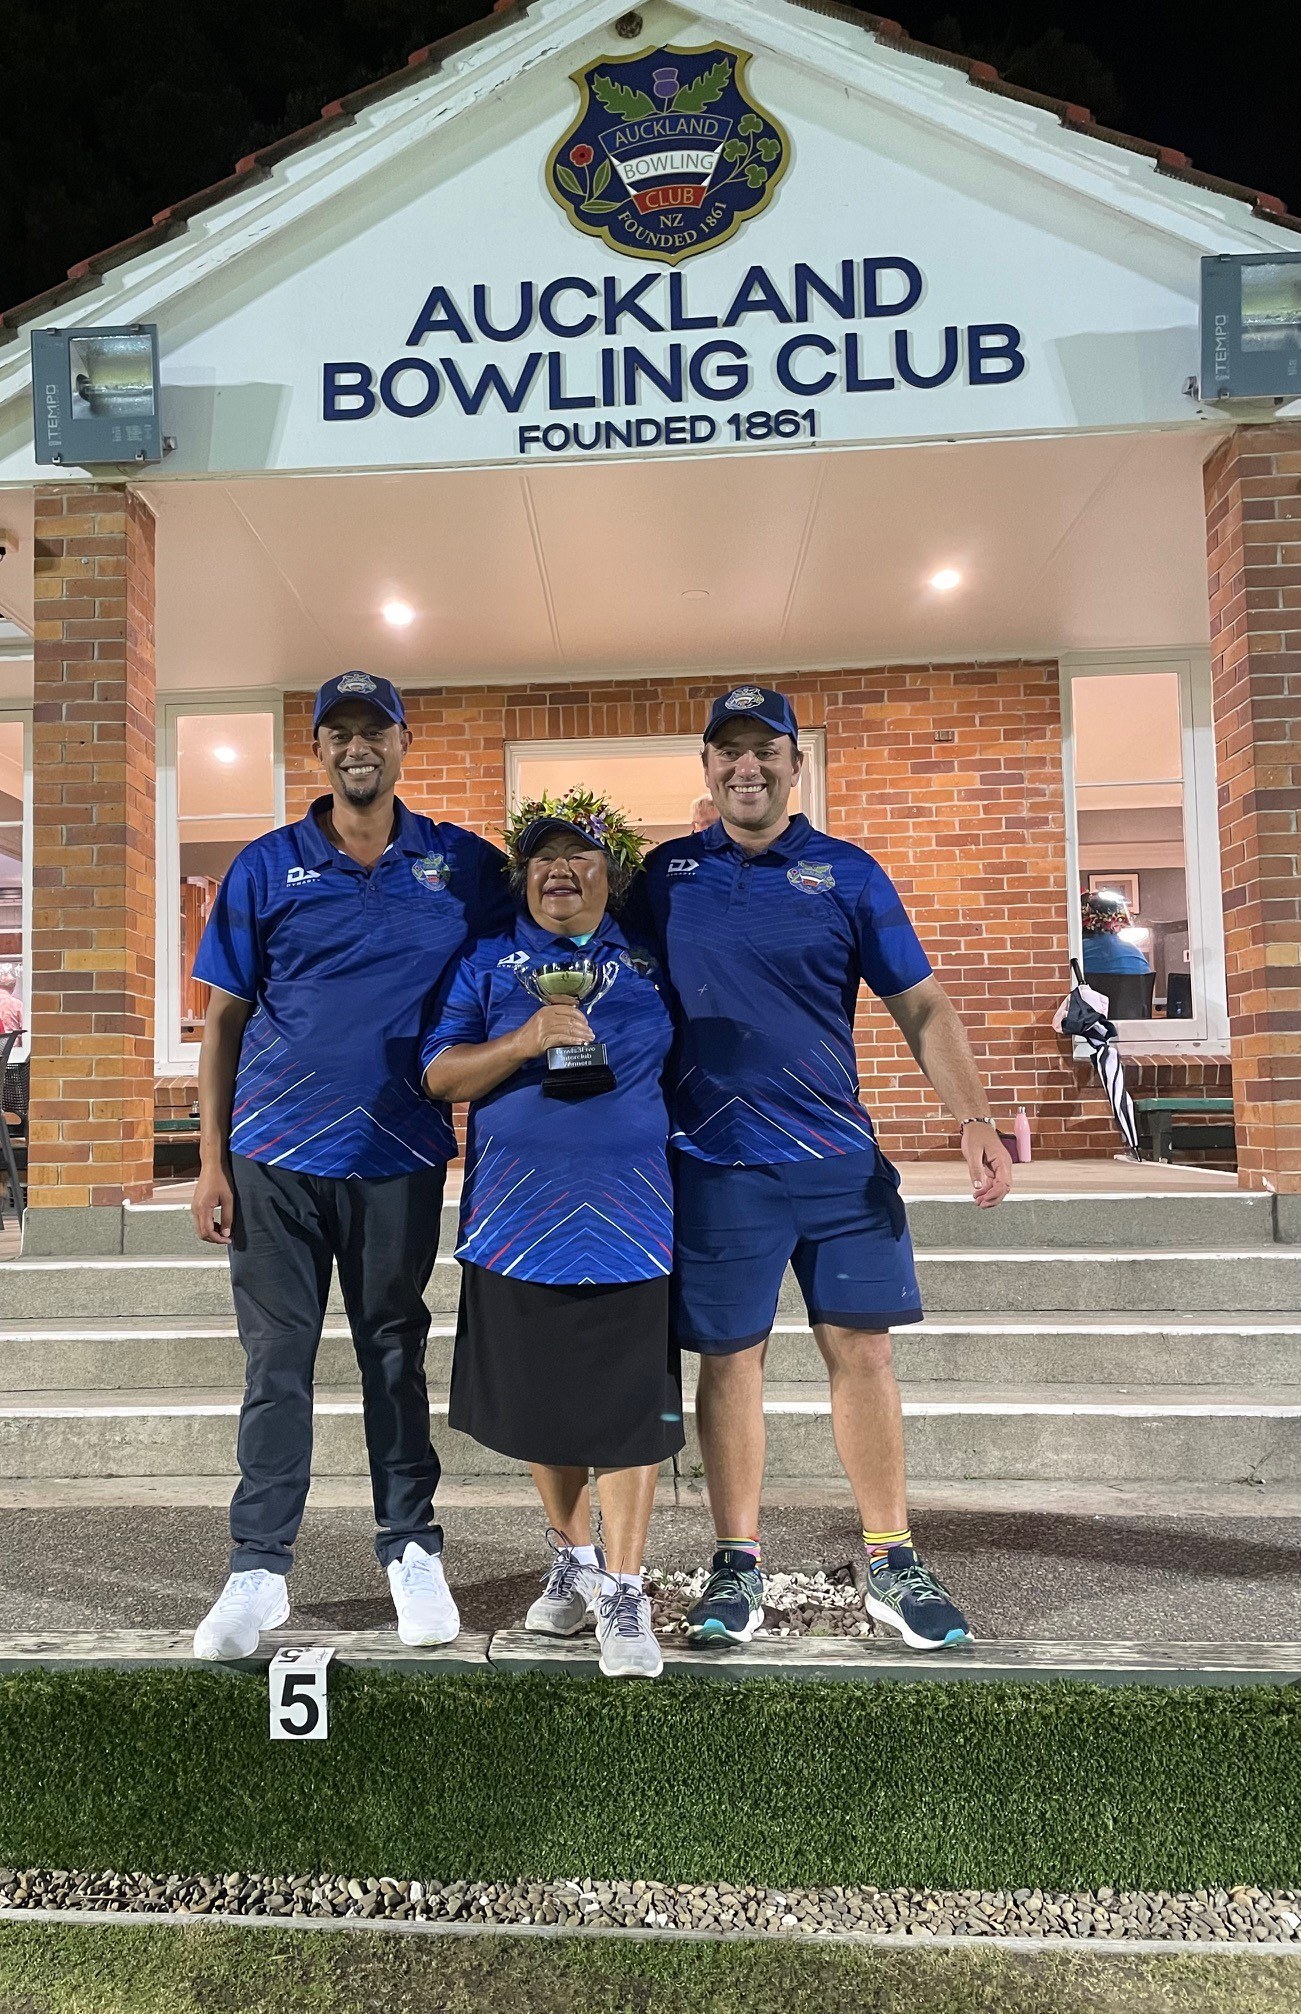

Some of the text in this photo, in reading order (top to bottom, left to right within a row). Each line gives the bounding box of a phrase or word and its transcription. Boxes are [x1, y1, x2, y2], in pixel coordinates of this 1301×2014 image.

[615, 118, 718, 148] AUCKLAND
[623, 153, 714, 179] BOWLING
[645, 188, 694, 208] CLUB
[659, 213, 684, 228] NZ
[617, 202, 727, 247] FOUNDED 1861
[406, 257, 922, 346] AUCKLAND
[1214, 314, 1228, 375] TEMPO
[323, 324, 1024, 421] BOWLING CLUB
[46, 384, 59, 440] TEMPO
[518, 409, 816, 453] FOUNDED 1861
[279, 1673, 319, 1735] 5
